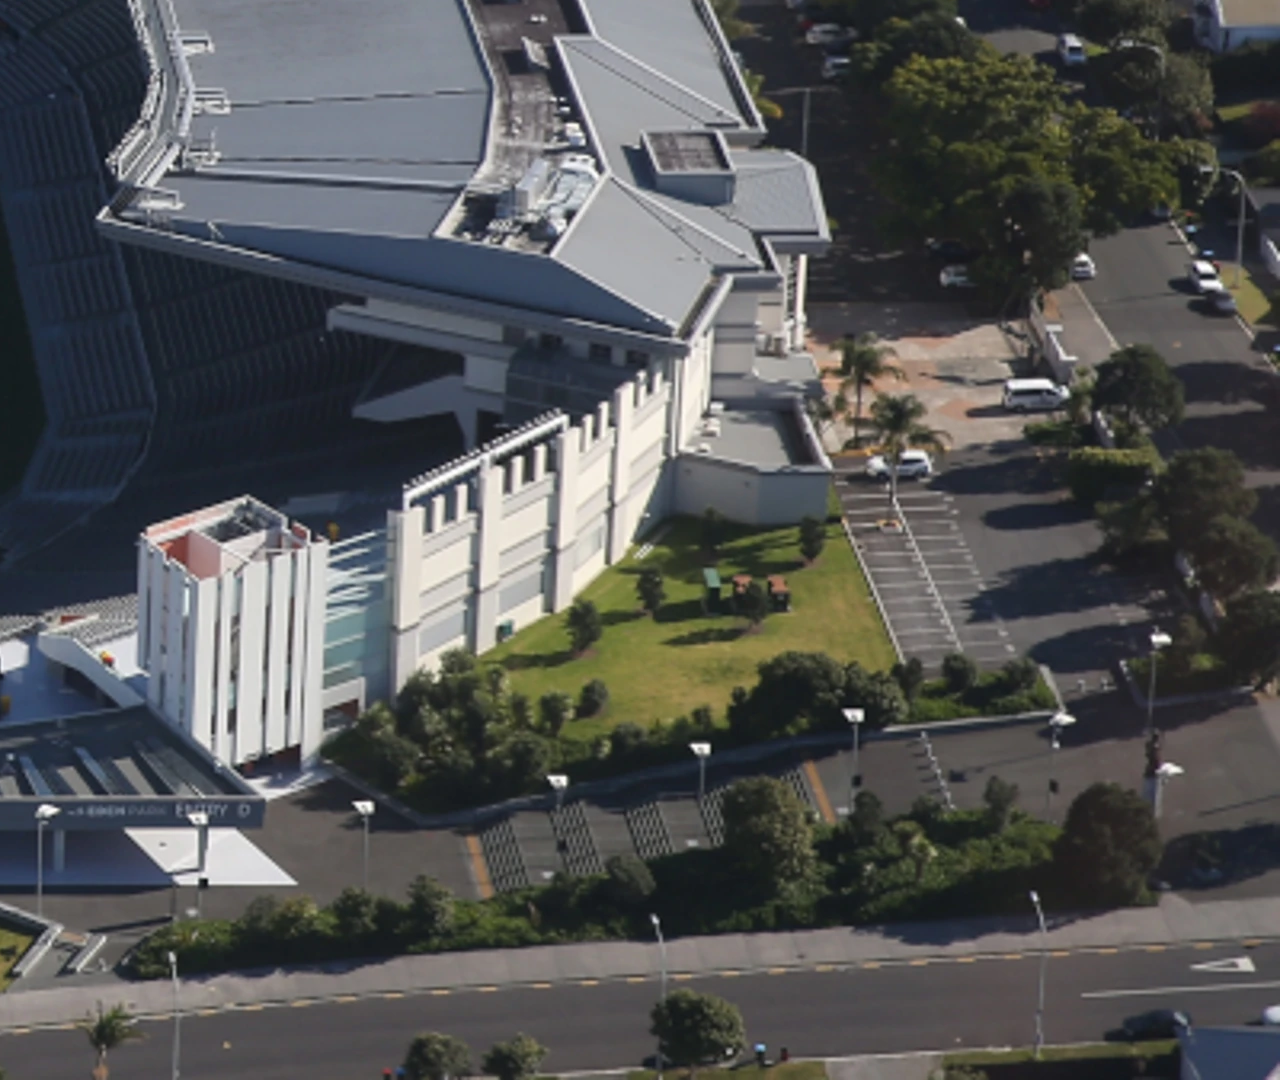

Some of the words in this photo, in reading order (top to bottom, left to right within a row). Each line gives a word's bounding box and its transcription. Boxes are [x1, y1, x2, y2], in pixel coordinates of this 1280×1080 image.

[88, 804, 126, 817] EDEN
[128, 805, 167, 816] PARK
[175, 802, 228, 819] ENTRY
[238, 803, 251, 819] D
